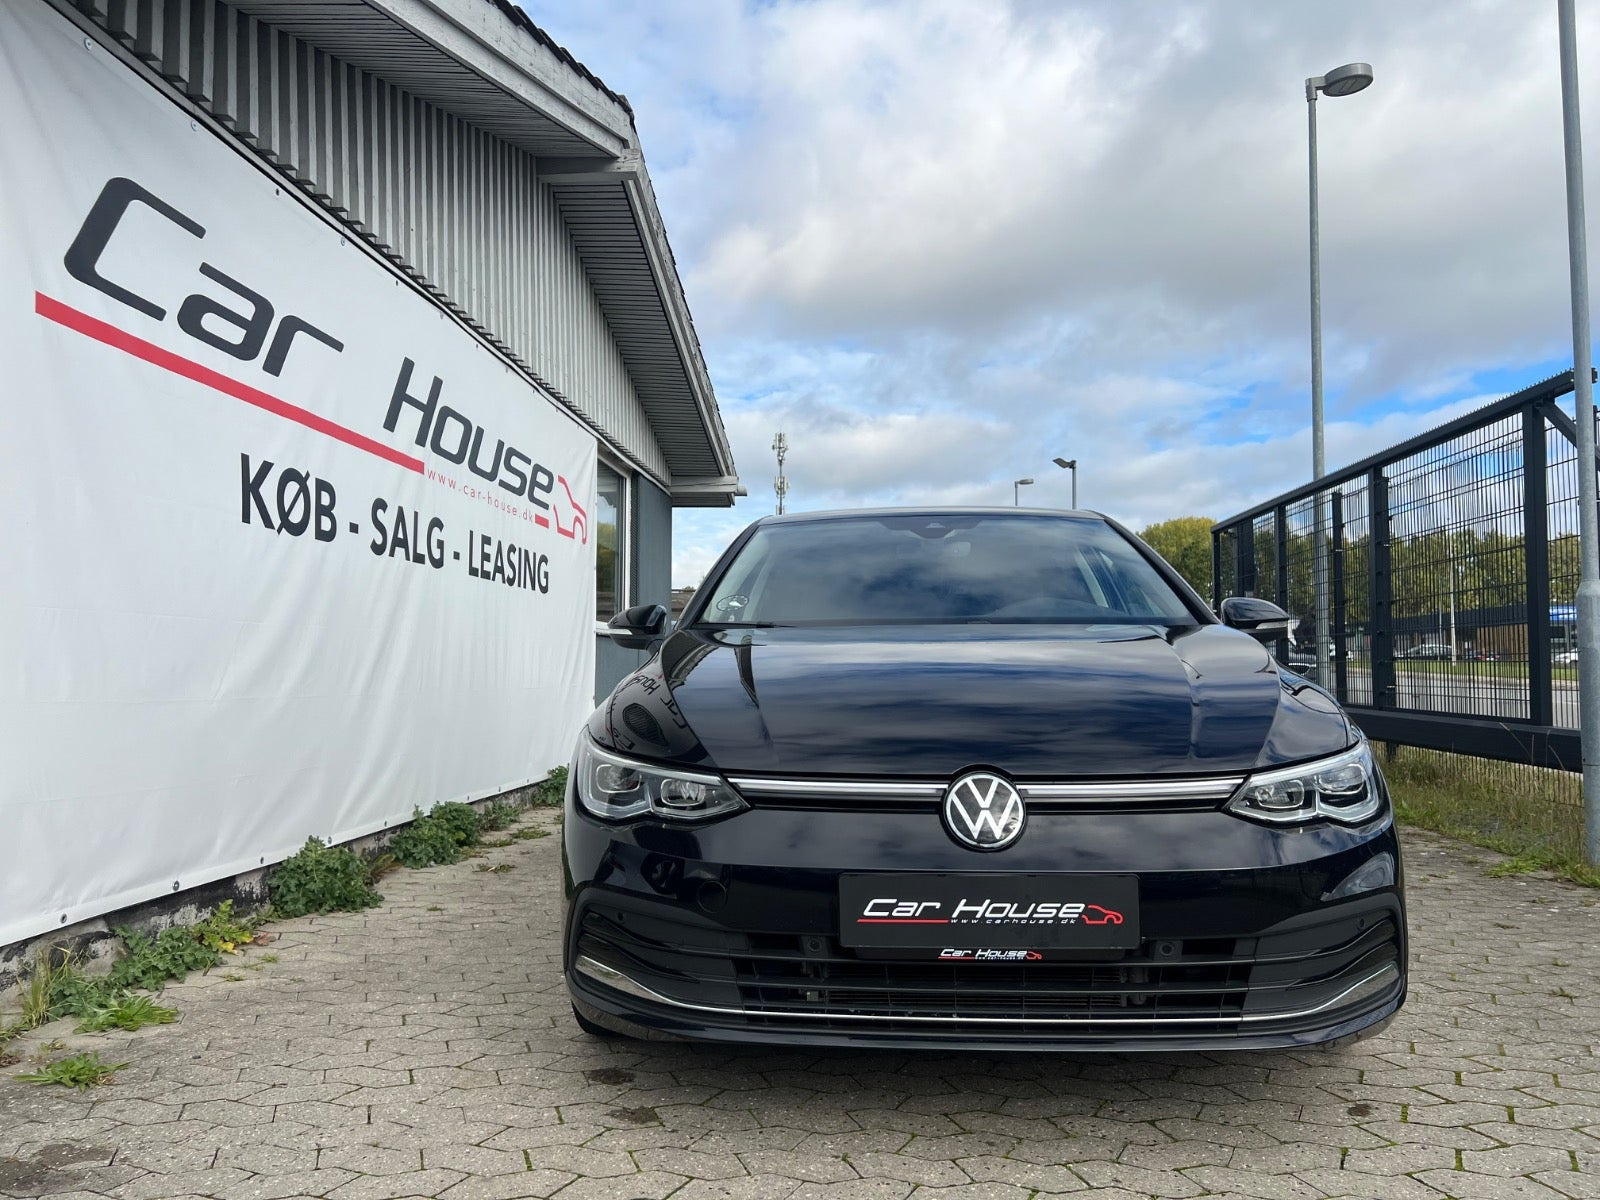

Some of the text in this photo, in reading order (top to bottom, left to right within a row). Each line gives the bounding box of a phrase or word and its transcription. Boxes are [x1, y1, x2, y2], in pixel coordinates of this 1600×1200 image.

[64, 177, 554, 511] Car House
[240, 452, 337, 542] KØB
[370, 498, 445, 569] SALG
[468, 529, 549, 594] LEASING
[427, 468, 534, 523] www.car-house.dk
[863, 899, 1085, 918] Car House
[940, 949, 1027, 957] Car House
